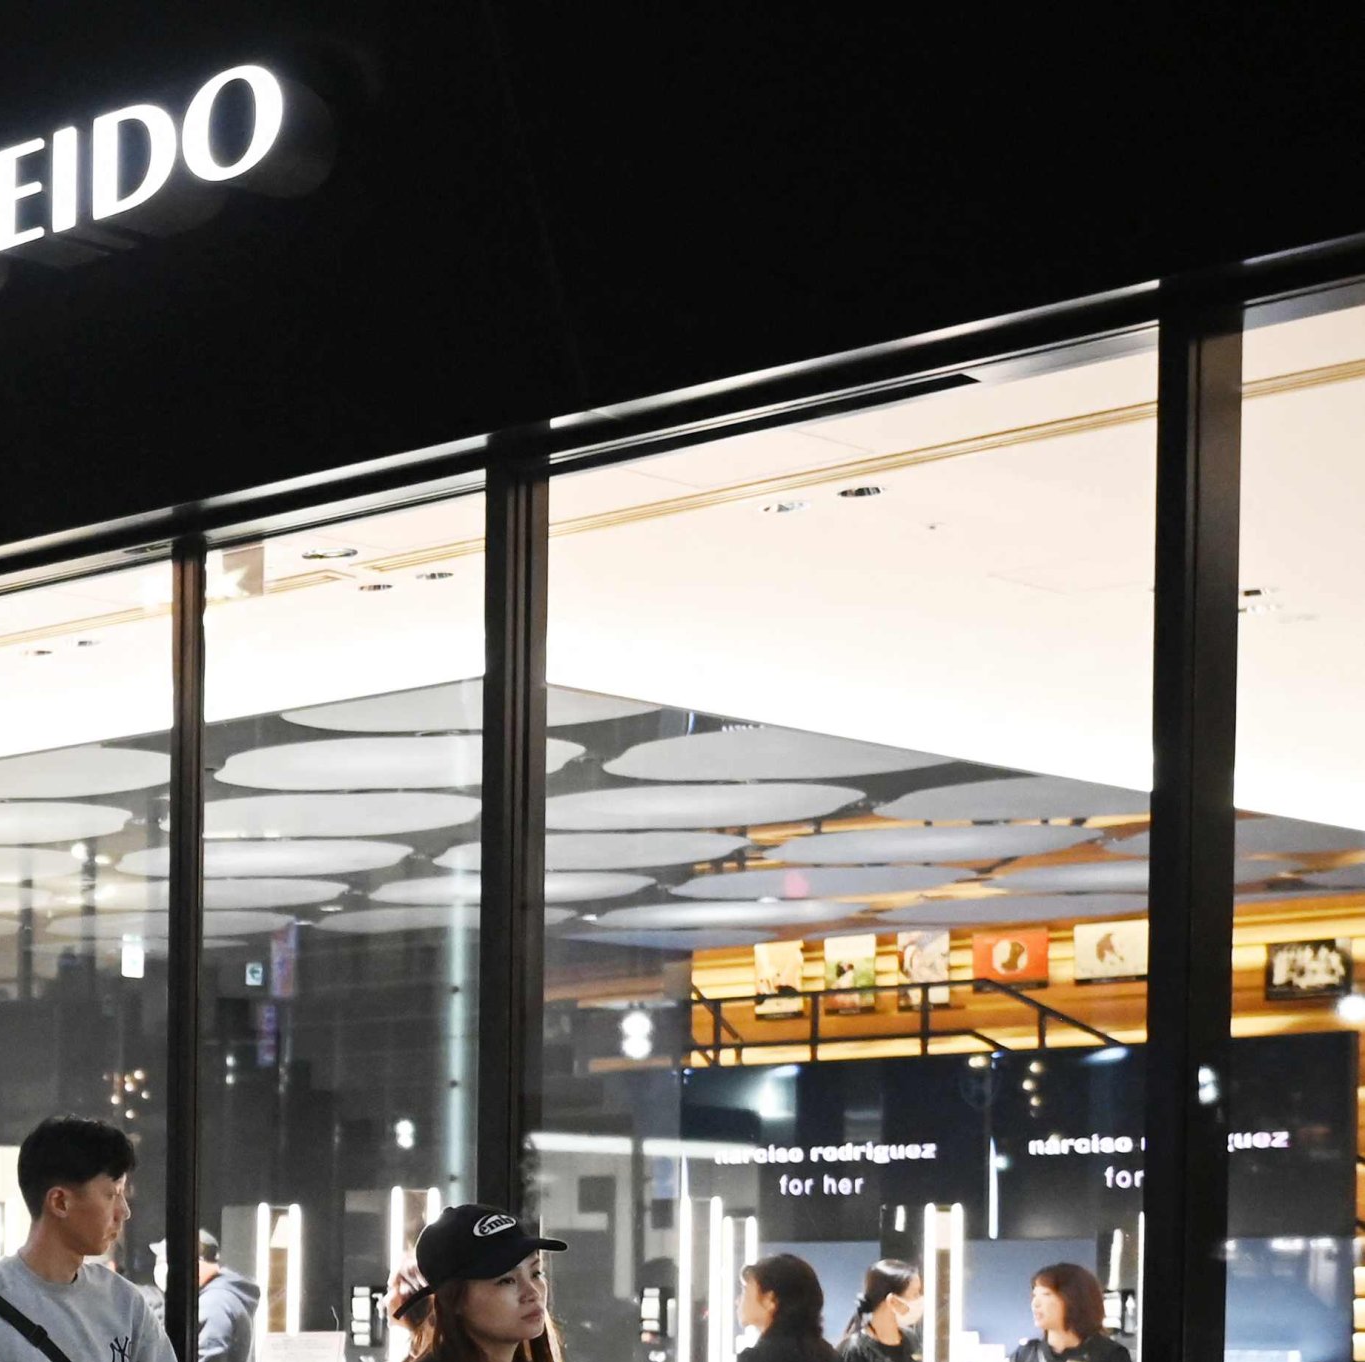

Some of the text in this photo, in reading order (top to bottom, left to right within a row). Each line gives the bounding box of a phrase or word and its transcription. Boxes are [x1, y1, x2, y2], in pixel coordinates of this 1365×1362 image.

[810, 1141, 937, 1164] rodriguez
[1028, 1133, 1133, 1156] narciso
[779, 1174, 864, 1196] for her
[1104, 1166, 1145, 1189] for
